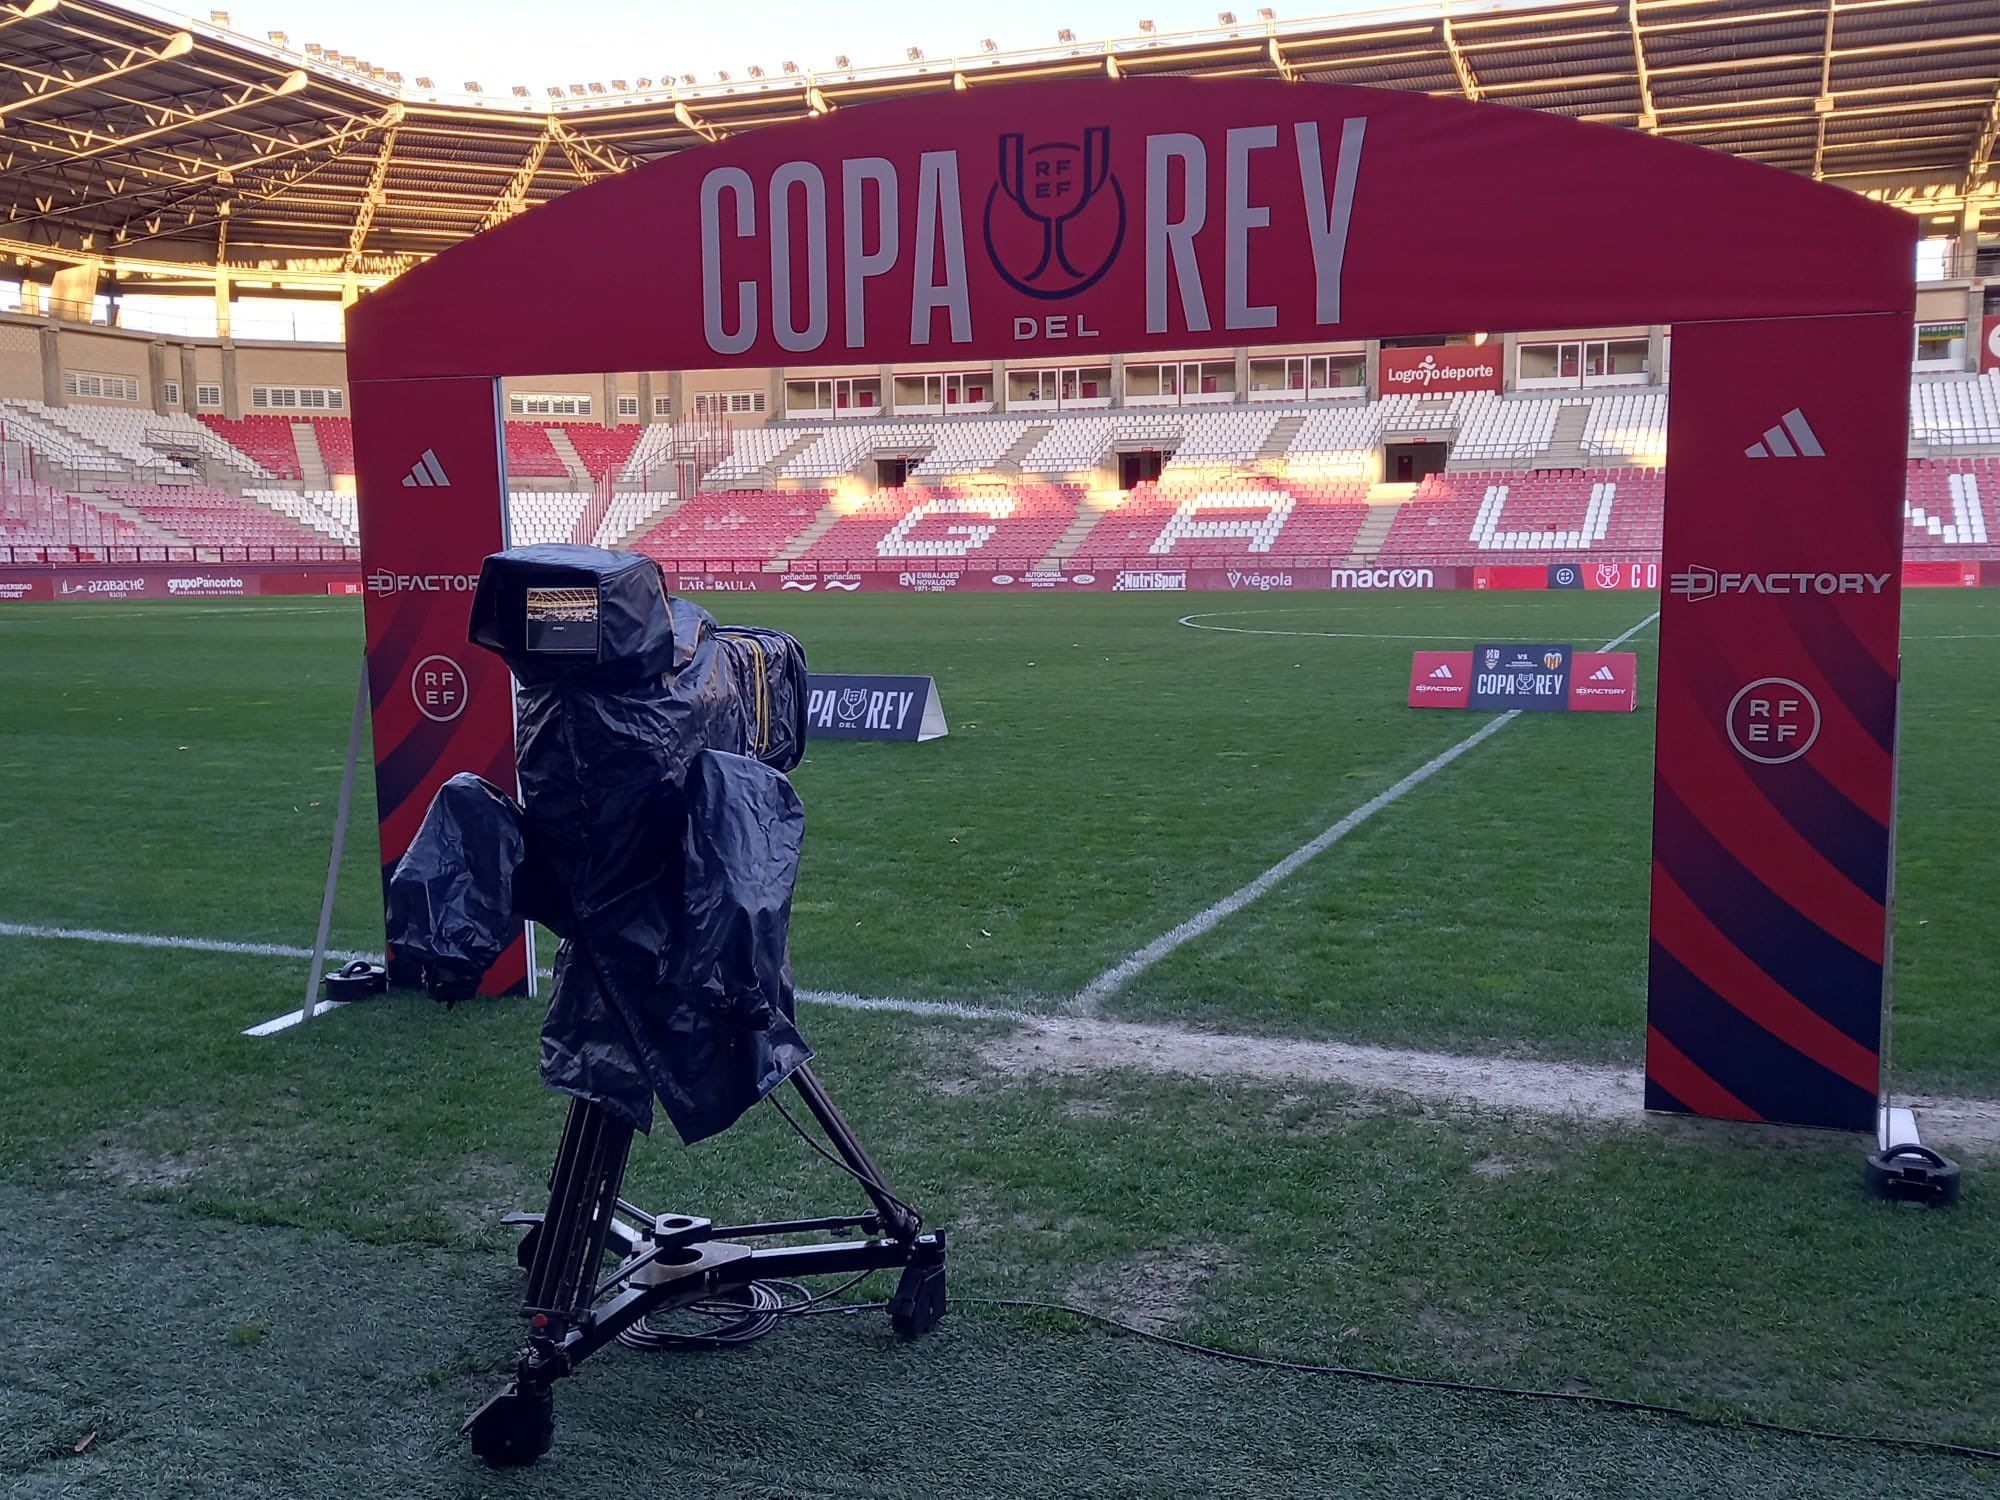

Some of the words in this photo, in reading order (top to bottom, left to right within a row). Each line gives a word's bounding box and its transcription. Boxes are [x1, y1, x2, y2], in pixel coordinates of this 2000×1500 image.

[700, 150, 973, 354] COPA
[1013, 314, 1100, 340] DEL
[1145, 117, 1367, 334] REY
[1441, 364, 1494, 381] deporte
[679, 580, 705, 591] LAR
[1124, 572, 1187, 590] NutriSport
[1331, 569, 1434, 588] macron
[1631, 564, 1657, 588] CO
[1477, 674, 1515, 694] COPA
[1535, 674, 1564, 695] REY
[807, 690, 837, 728] PA
[865, 690, 914, 730] REY
